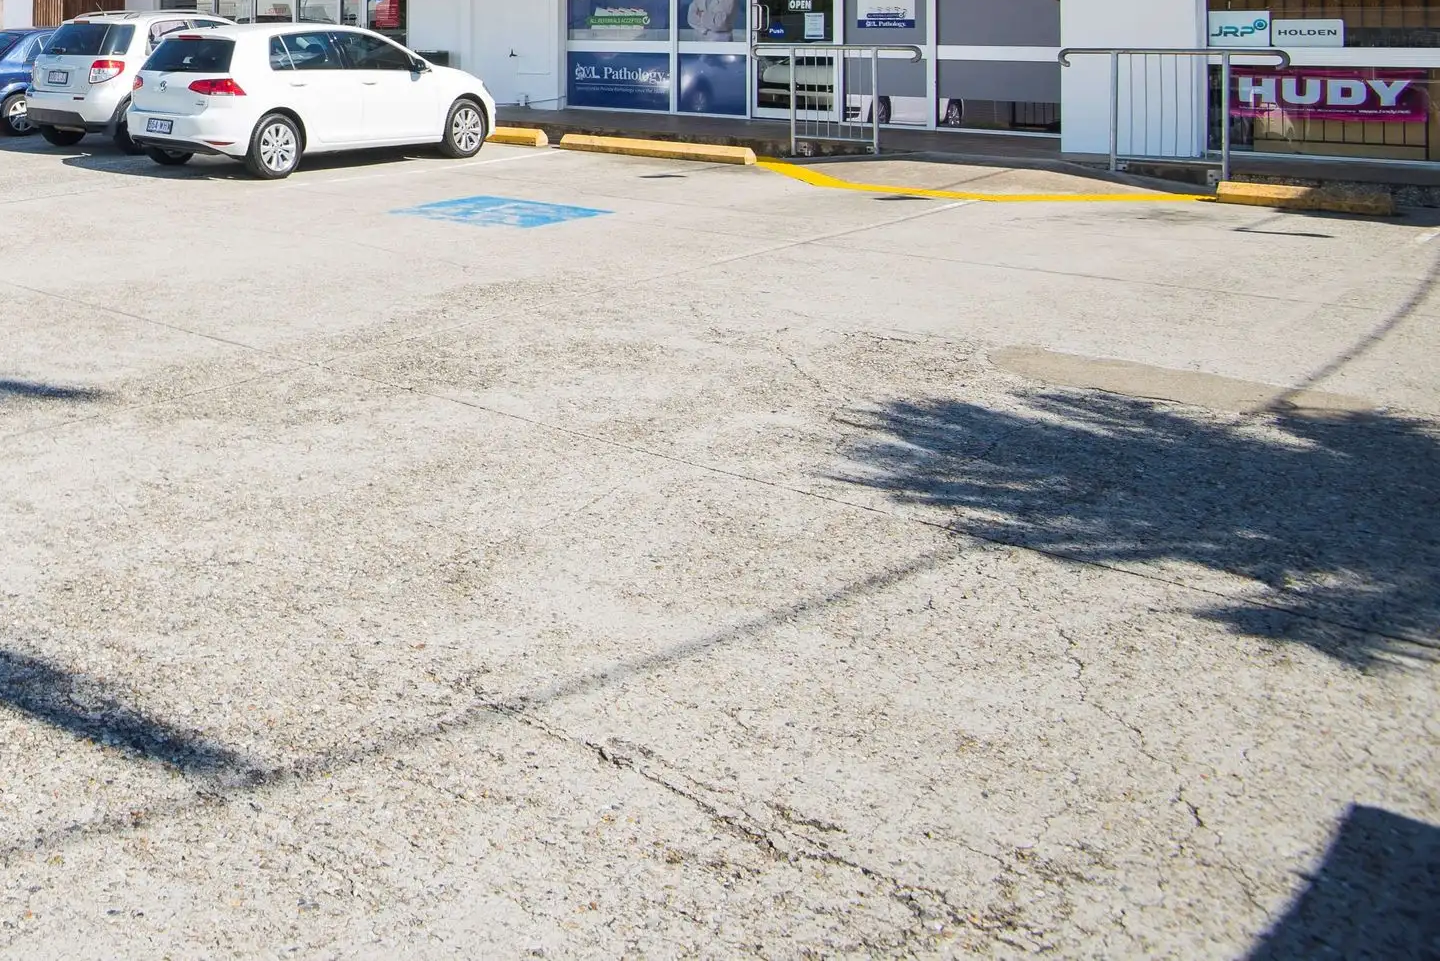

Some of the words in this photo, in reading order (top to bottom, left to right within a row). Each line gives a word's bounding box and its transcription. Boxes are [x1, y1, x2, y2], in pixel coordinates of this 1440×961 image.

[789, 0, 811, 9] OPEN
[1211, 26, 1255, 37] JRP
[1238, 76, 1411, 107] HUDY
